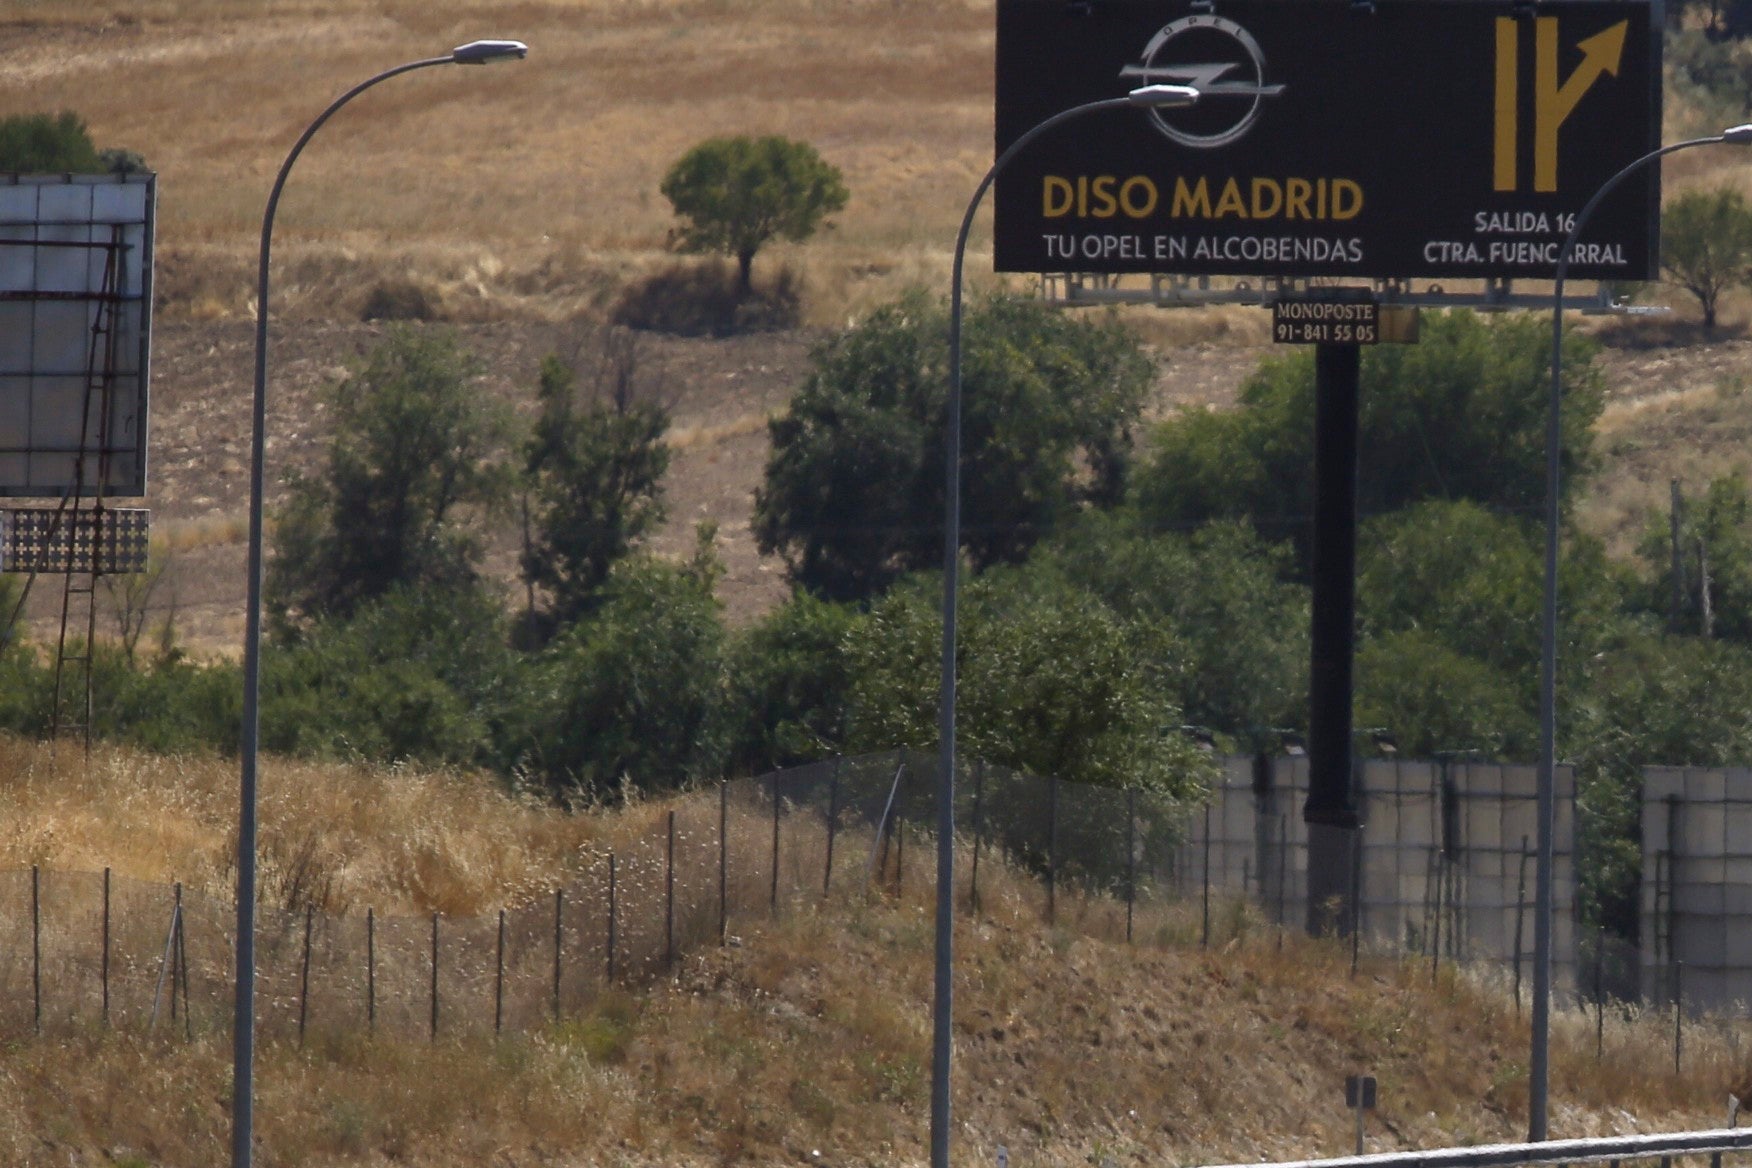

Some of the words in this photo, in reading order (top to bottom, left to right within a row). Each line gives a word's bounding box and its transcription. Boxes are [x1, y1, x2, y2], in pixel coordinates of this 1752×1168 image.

[1043, 175, 1158, 218] DISO
[1171, 176, 1364, 219] MADRID
[1474, 212, 1550, 232] SALIDA
[1556, 213, 1576, 233] 16
[1043, 235, 1075, 258] TU
[1082, 235, 1146, 259] OPEL
[1154, 235, 1186, 259] EN
[1193, 236, 1363, 262] ALCOBENDAS
[1424, 241, 1485, 263] CTRA.
[1490, 242, 1627, 264] FUENCRRAL
[1277, 303, 1374, 319] MONOPOSTE
[1334, 325, 1351, 341] 55
[1356, 325, 1374, 341] 05
